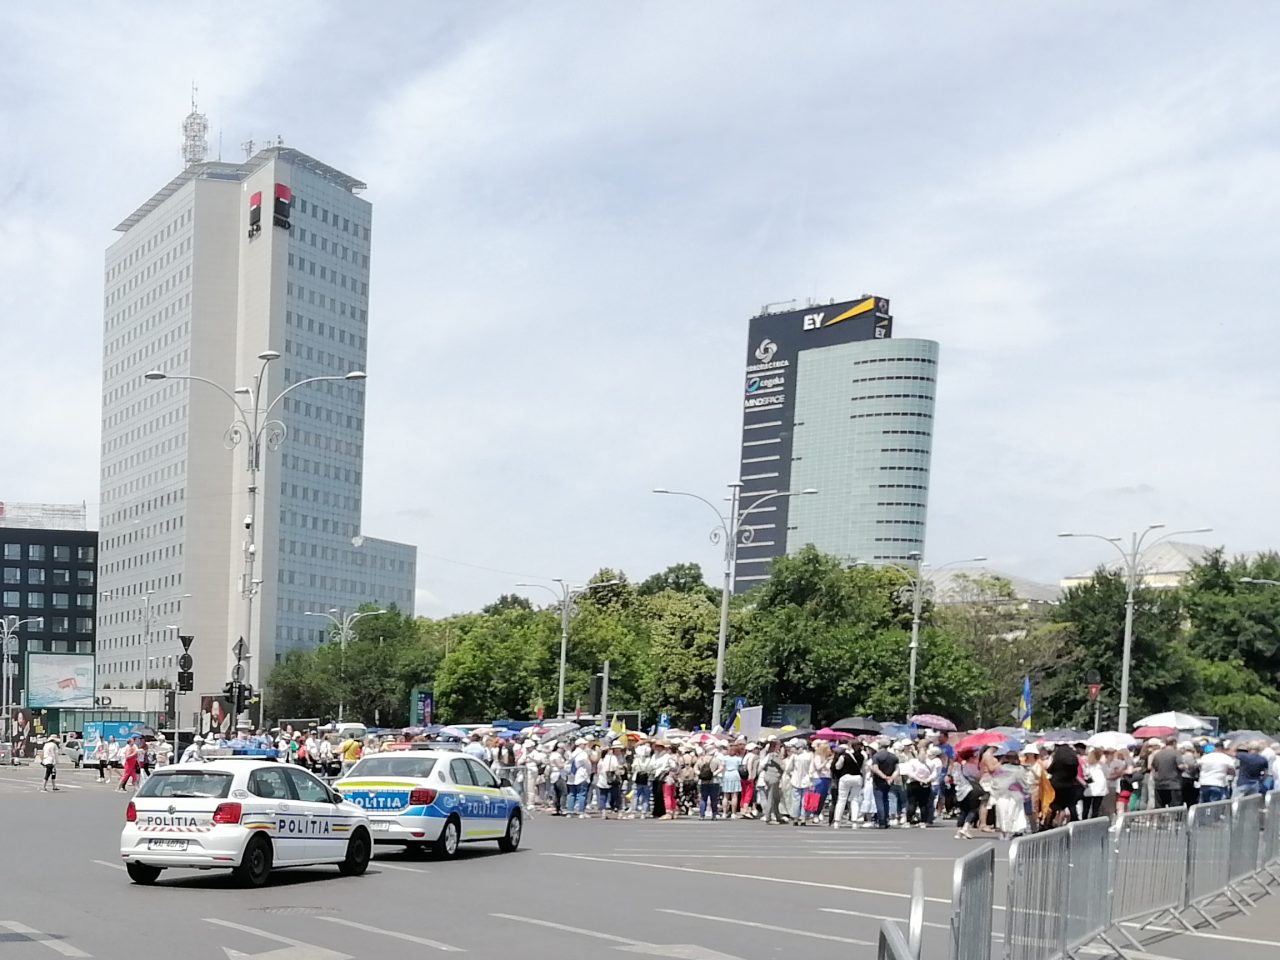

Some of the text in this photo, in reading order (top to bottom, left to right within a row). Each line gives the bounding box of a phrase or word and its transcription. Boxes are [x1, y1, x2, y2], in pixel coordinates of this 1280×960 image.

[803, 313, 824, 330] EY
[147, 816, 198, 826] POLITIA
[278, 819, 329, 834] POLITIA
